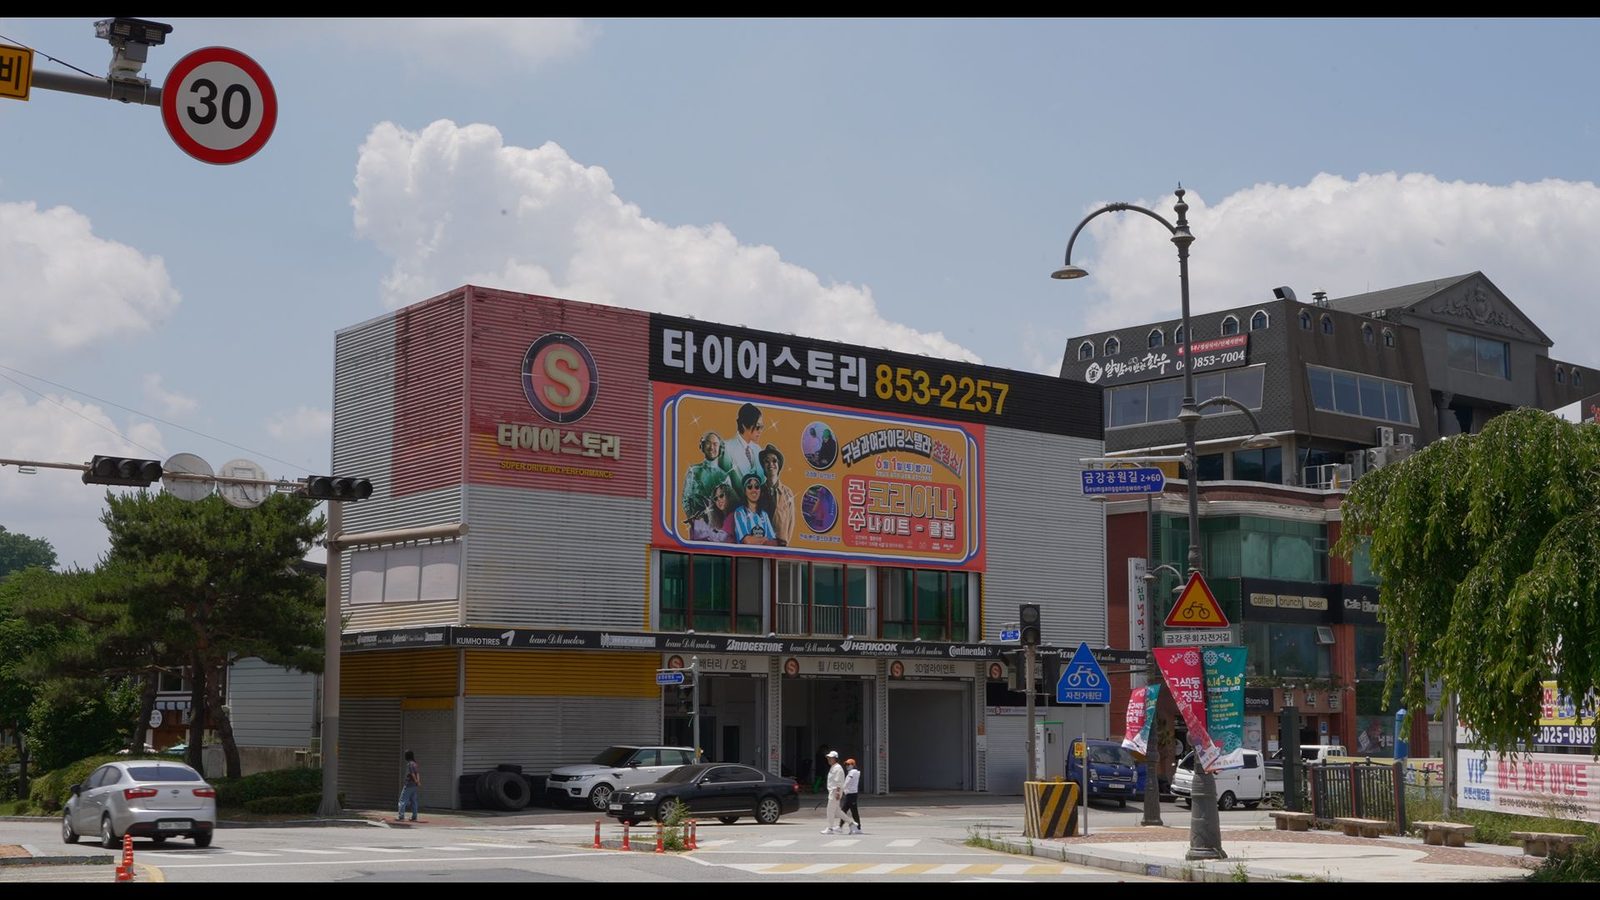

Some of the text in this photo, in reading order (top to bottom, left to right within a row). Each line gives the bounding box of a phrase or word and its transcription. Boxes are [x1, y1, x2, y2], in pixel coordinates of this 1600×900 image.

[187, 79, 251, 130] 30
[543, 348, 581, 407] S
[662, 328, 1010, 416] 타이어스토리 853-2257
[497, 423, 621, 461] 타이어스토리
[500, 461, 526, 471] SUPER
[562, 467, 613, 478] PERFORMANCE
[1084, 471, 1137, 483] 금강공원길
[1085, 485, 1151, 493] Geumganggongwon-gil
[848, 479, 866, 531] 공주
[868, 480, 957, 521] 코리아나
[868, 516, 911, 536] 나이트
[929, 521, 956, 539] 클럽
[1253, 596, 1274, 605] coffee
[1279, 597, 1302, 606] brunch
[1308, 599, 1323, 608] beer
[726, 639, 784, 652] BRIDGESTONE
[949, 645, 987, 657] Continental
[731, 660, 747, 670] 오일
[832, 661, 854, 672] 타이어
[1066, 691, 1102, 700] 자전거횡단
[1550, 763, 1588, 797] 이벤트
